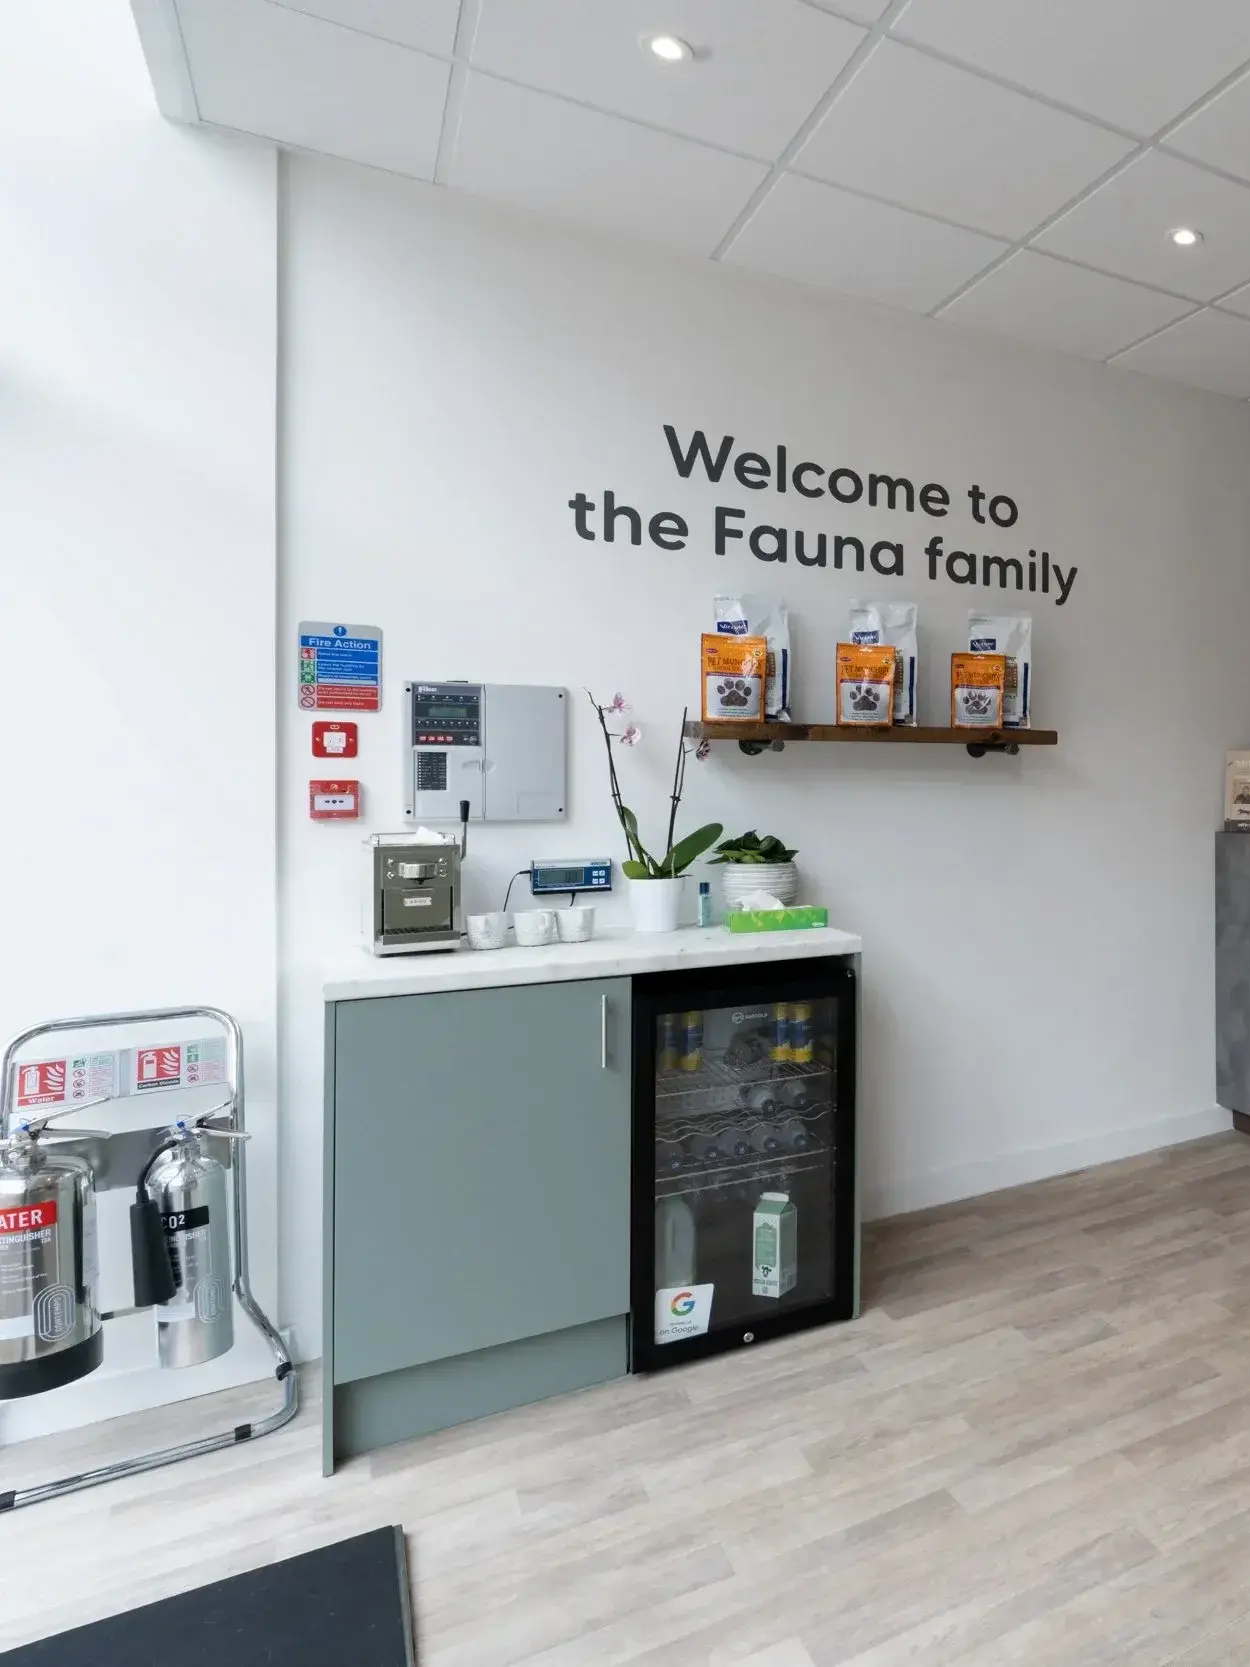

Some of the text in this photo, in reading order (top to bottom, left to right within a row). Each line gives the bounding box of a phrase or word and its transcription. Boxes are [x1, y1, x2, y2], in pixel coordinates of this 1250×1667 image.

[662, 424, 1018, 528] Welcome to
[568, 490, 1078, 606] the Fauna family
[308, 638, 372, 650] Fire Action
[27, 1096, 56, 1104] Water
[671, 1325, 699, 1334] Google
